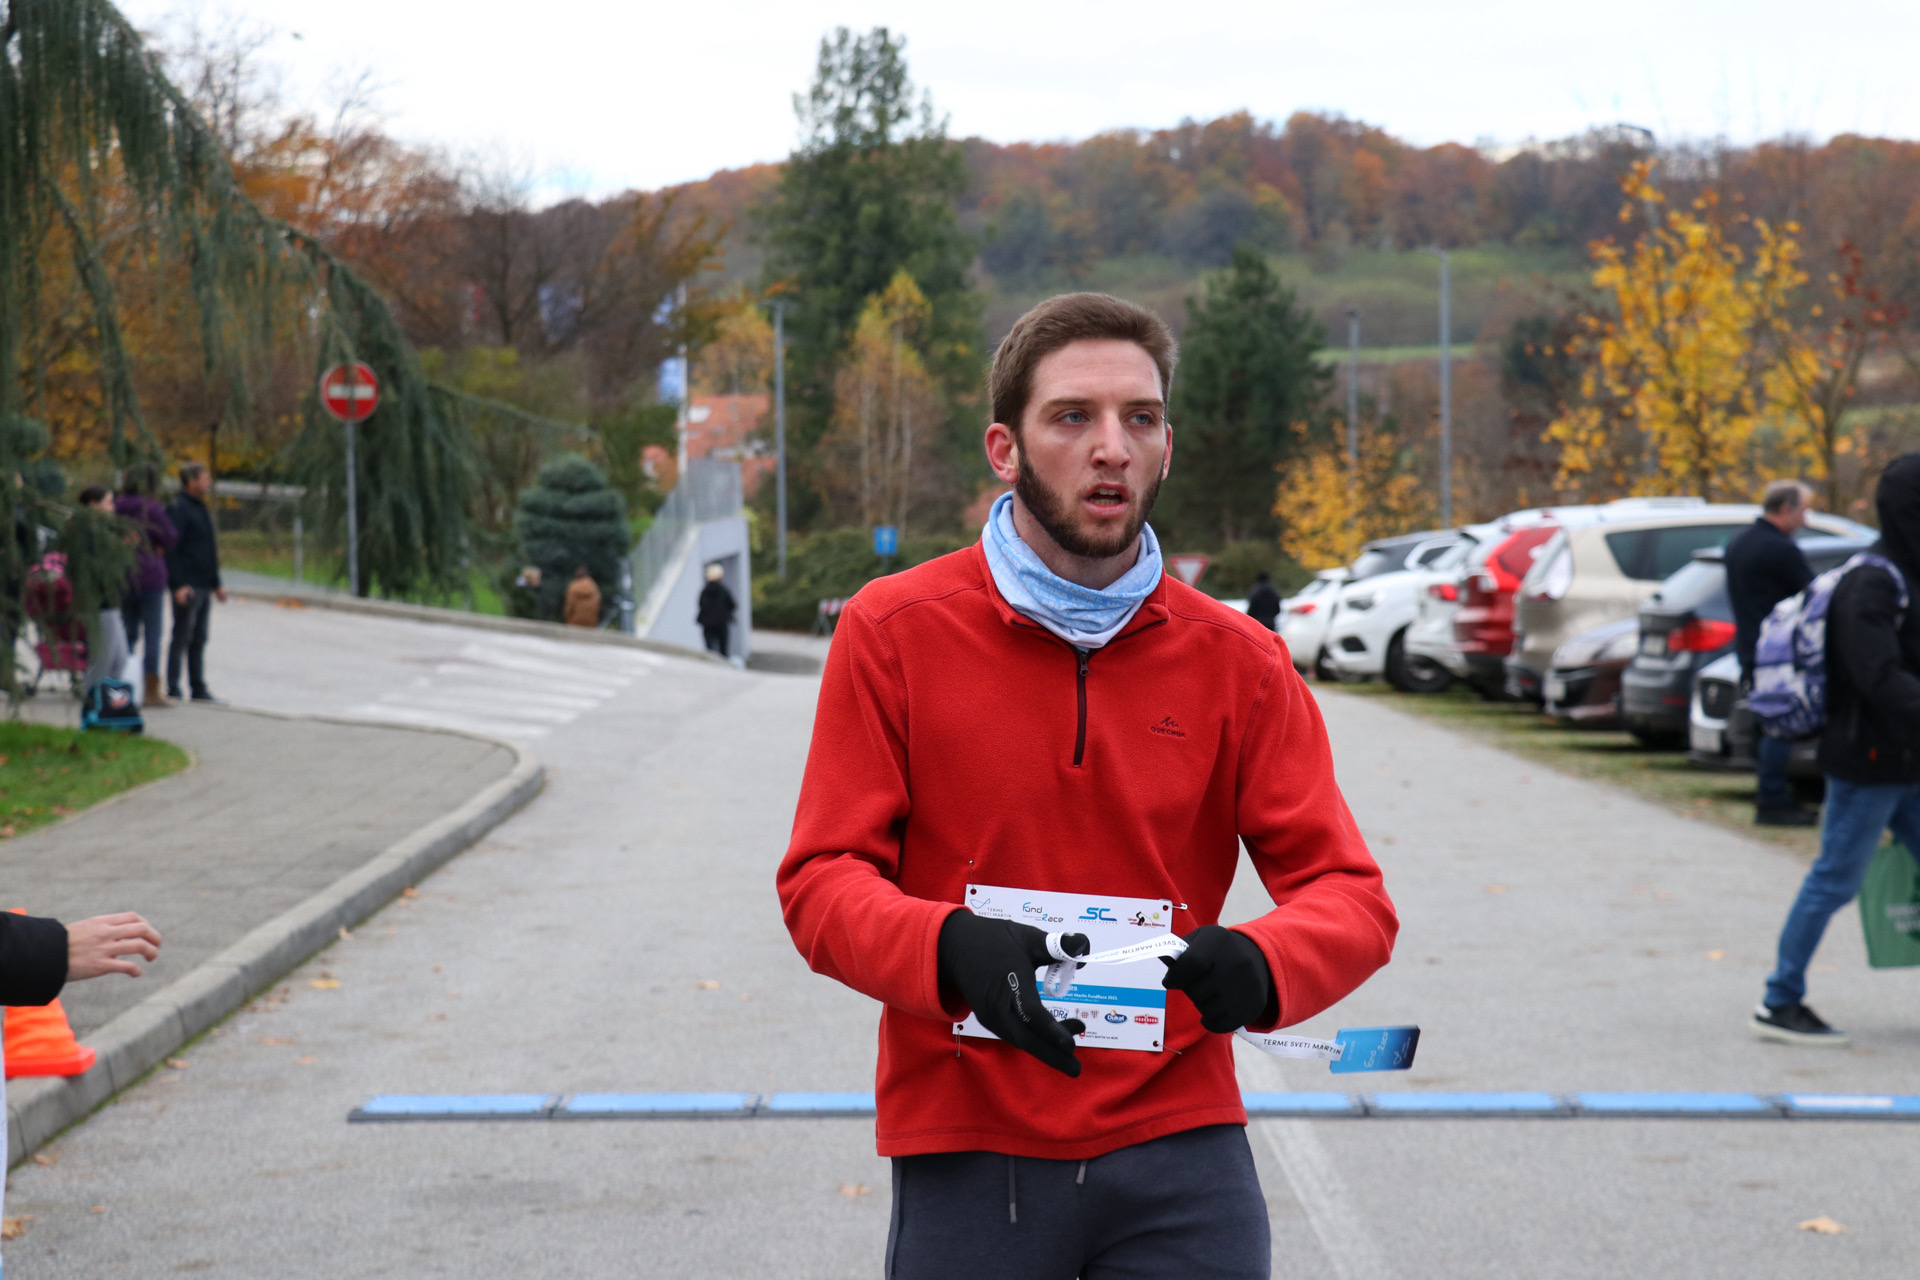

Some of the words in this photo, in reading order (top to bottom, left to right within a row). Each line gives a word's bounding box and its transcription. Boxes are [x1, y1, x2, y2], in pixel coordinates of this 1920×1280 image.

[1022, 902, 1043, 913] Fund
[1078, 907, 1118, 921] SC
[1122, 944, 1153, 955] MARTIN
[1154, 940, 1176, 948] SVETI
[1263, 1038, 1288, 1047] TERME
[1290, 1041, 1311, 1049] SVETI
[1312, 1044, 1342, 1055] MARTIN
